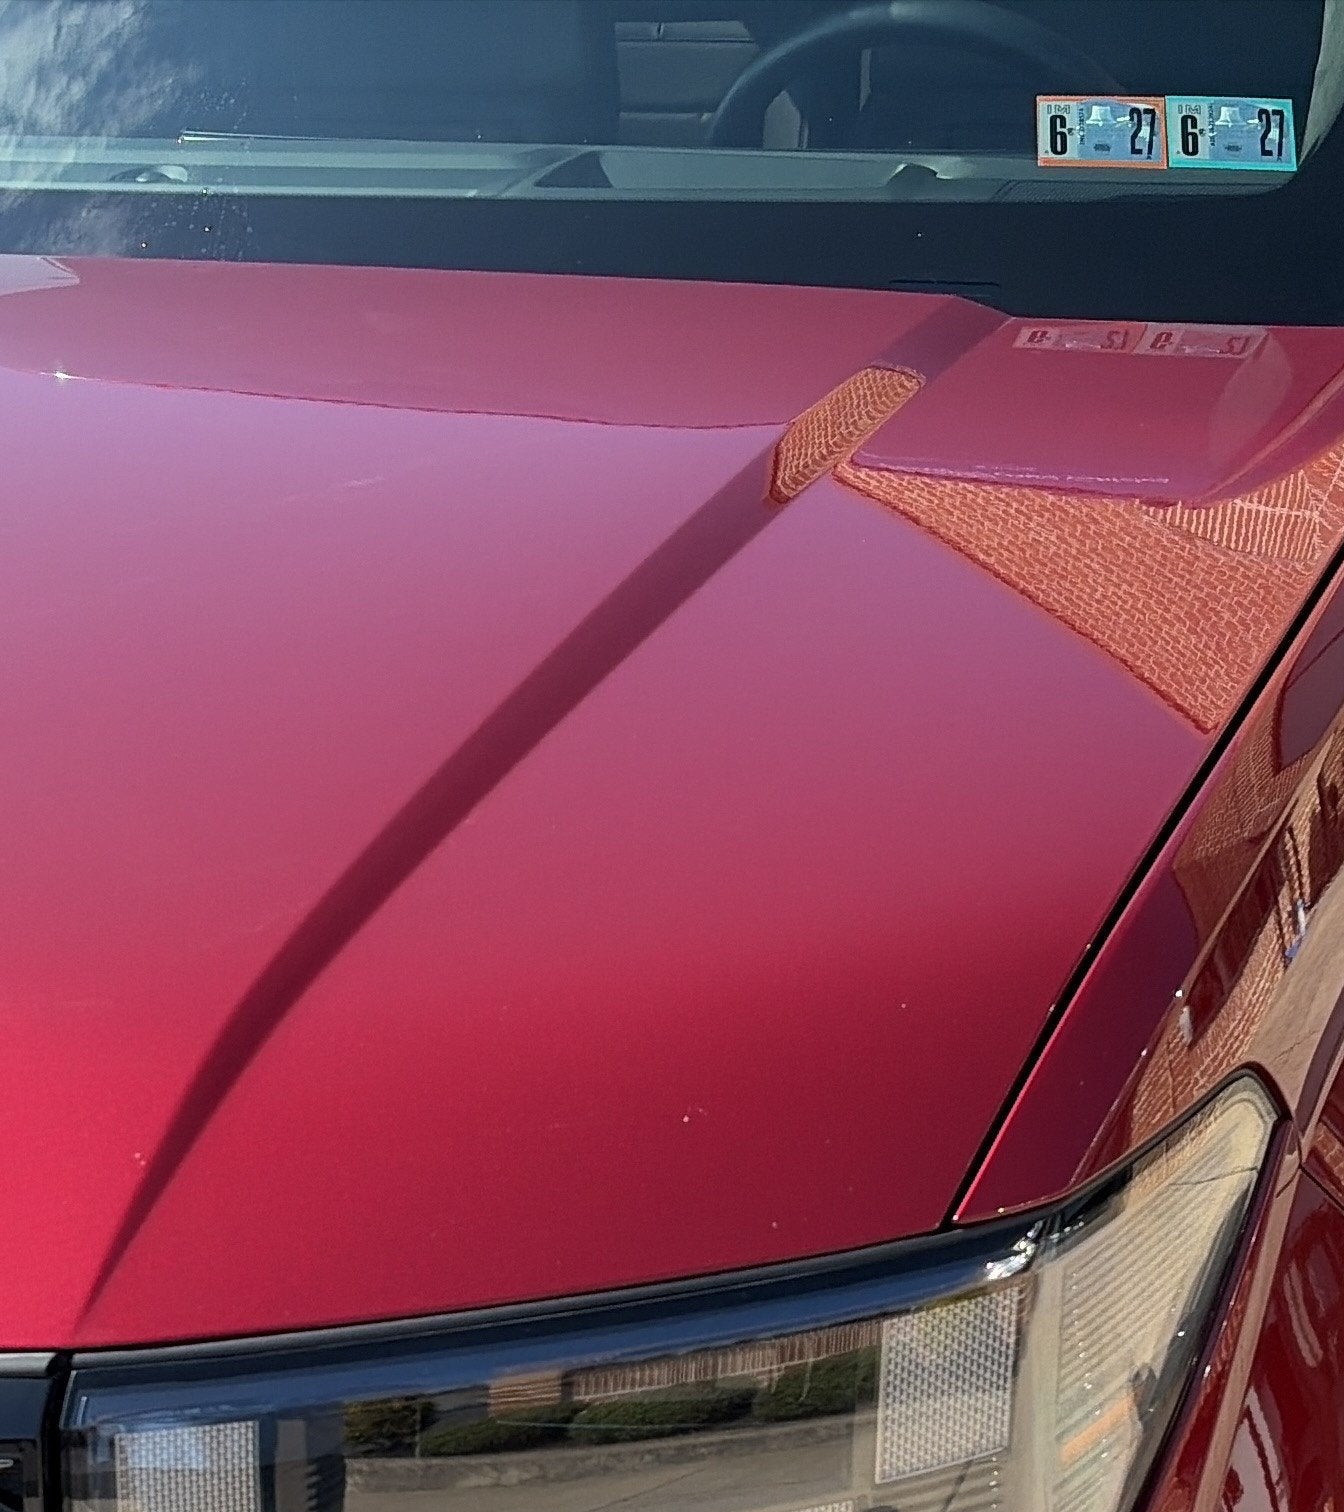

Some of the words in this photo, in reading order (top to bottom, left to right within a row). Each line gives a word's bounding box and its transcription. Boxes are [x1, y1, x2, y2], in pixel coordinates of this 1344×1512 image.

[1049, 114, 1068, 156] 6
[1128, 107, 1156, 156] 27
[1180, 114, 1199, 157] 6
[1257, 108, 1285, 157] 27
